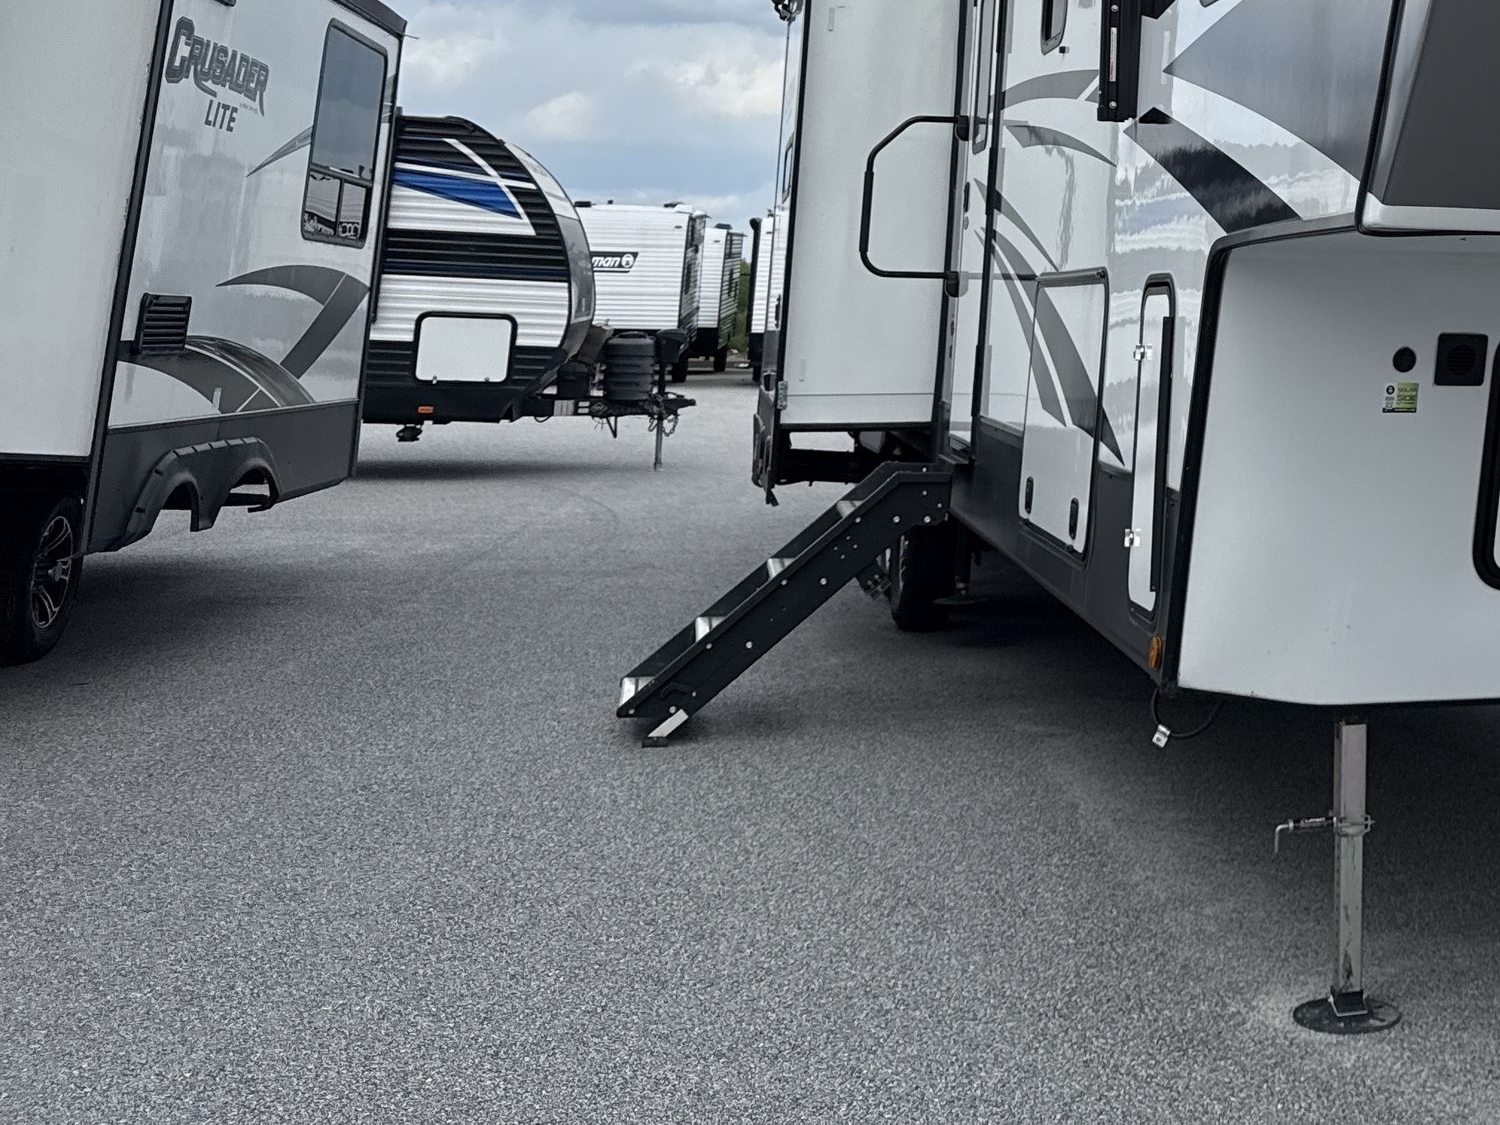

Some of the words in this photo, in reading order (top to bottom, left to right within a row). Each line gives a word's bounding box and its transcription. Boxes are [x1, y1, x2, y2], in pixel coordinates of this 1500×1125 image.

[165, 16, 270, 117] CRUSADER
[204, 99, 239, 132] LITE
[592, 256, 621, 268] man
